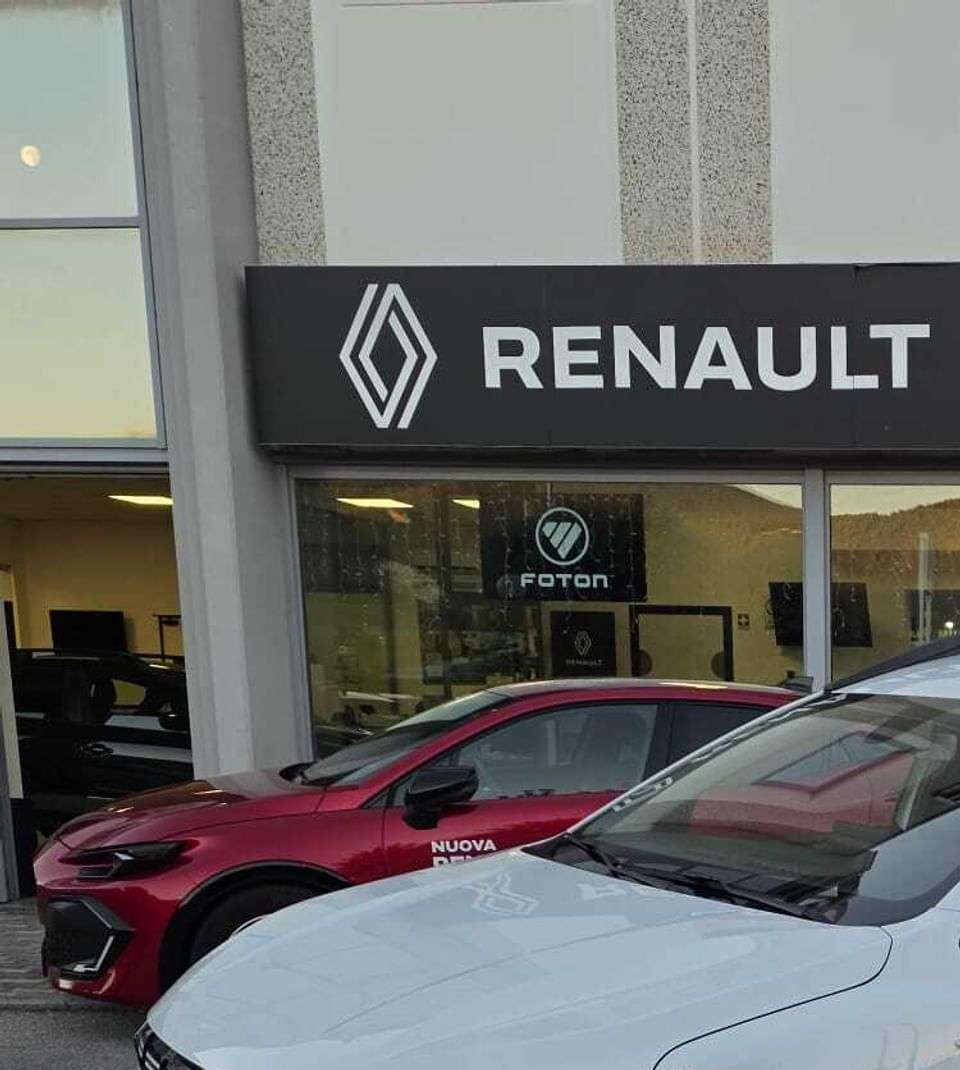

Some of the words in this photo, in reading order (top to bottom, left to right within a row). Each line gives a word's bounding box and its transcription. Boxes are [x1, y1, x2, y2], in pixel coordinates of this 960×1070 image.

[482, 323, 931, 391] RENAULT
[520, 573, 609, 588] FOTON
[431, 839, 497, 853] NUOVA
